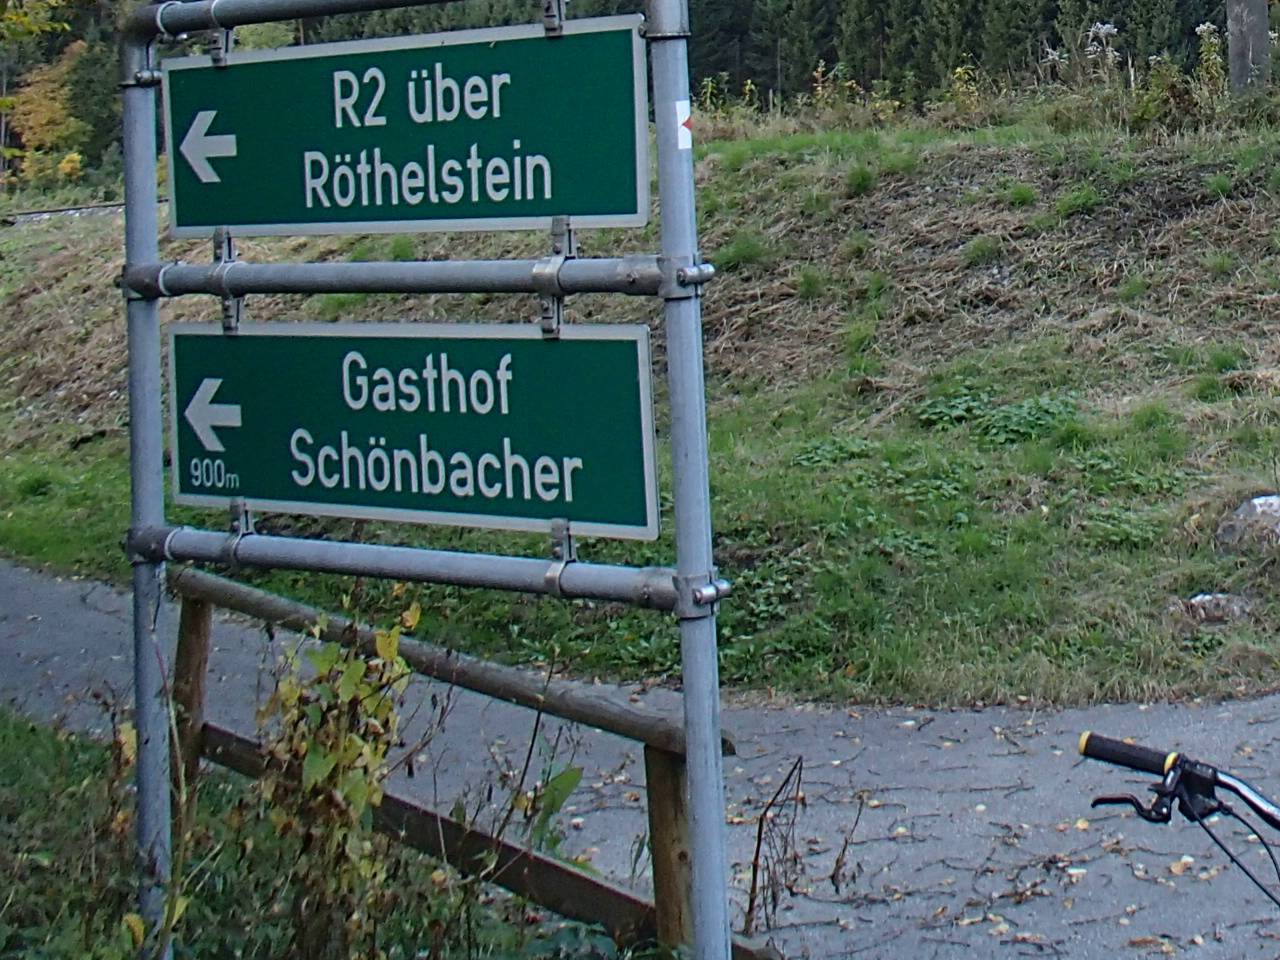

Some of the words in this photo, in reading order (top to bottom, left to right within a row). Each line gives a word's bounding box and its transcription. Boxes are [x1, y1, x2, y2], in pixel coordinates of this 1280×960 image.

[333, 68, 388, 129] R2
[407, 62, 512, 123] über
[303, 140, 553, 209] Röthelstein
[341, 351, 513, 415] Gasthof
[189, 458, 240, 489] 900m
[289, 428, 583, 503] Schönbacher
